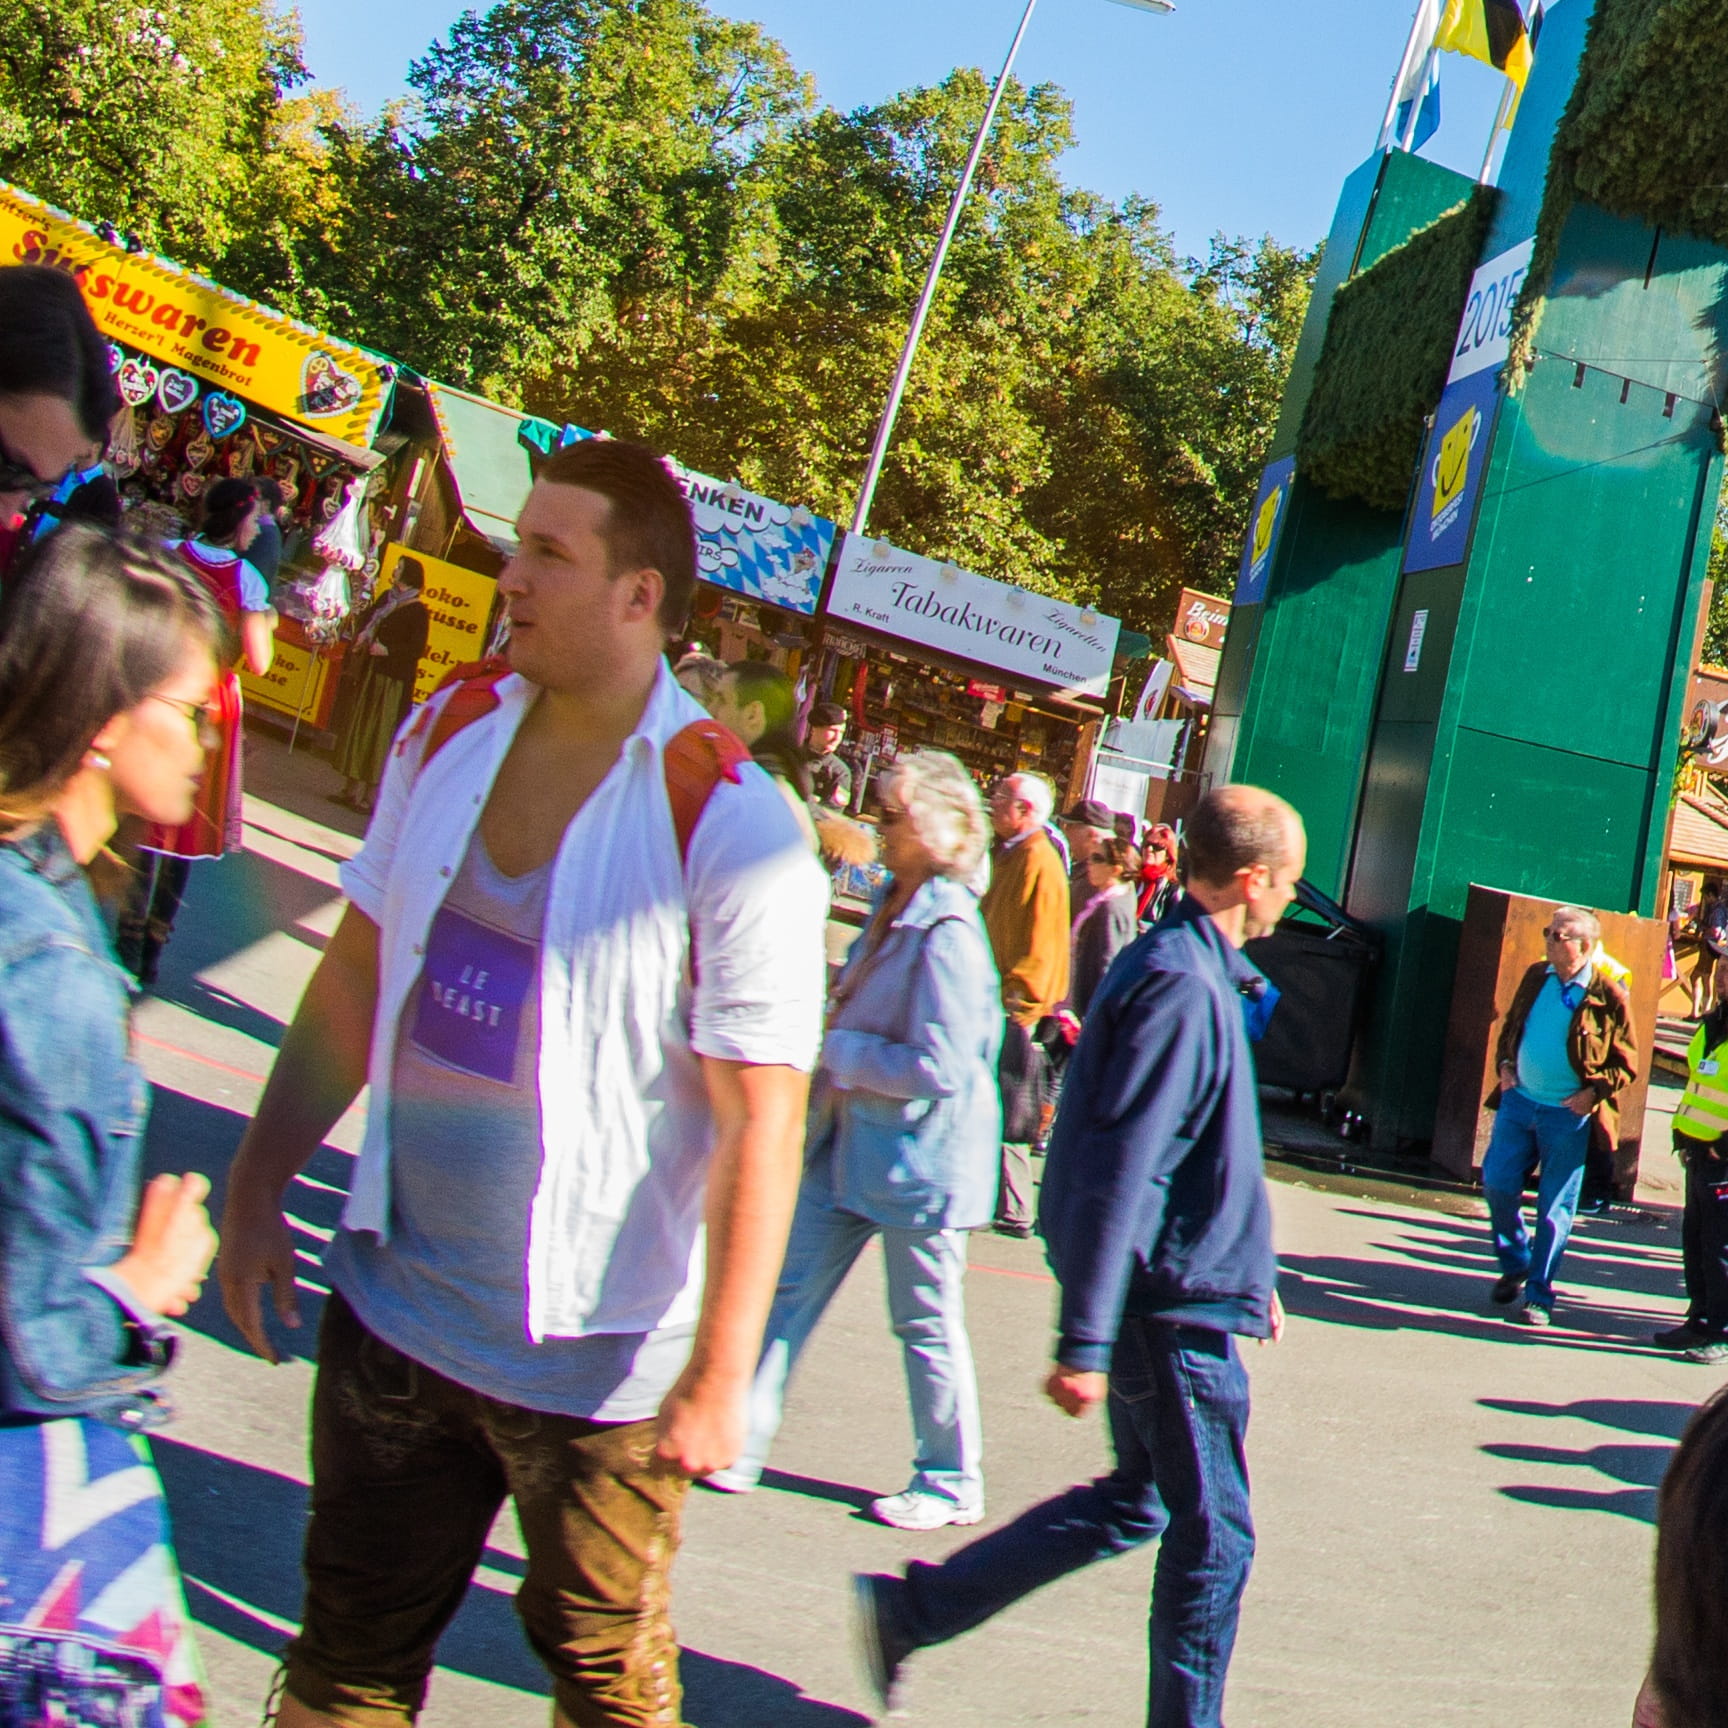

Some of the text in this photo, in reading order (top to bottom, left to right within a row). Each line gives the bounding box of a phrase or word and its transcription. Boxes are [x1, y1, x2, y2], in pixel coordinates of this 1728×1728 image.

[1456, 267, 1525, 358] 2015
[171, 342, 252, 387] Magenbrot
[851, 557, 913, 577] Zigarren
[852, 602, 890, 623] R. Kraft
[891, 580, 1062, 660] Tabakwaren
[1043, 607, 1107, 653] Zigaretten
[1042, 662, 1087, 684] München
[459, 964, 491, 990] LE
